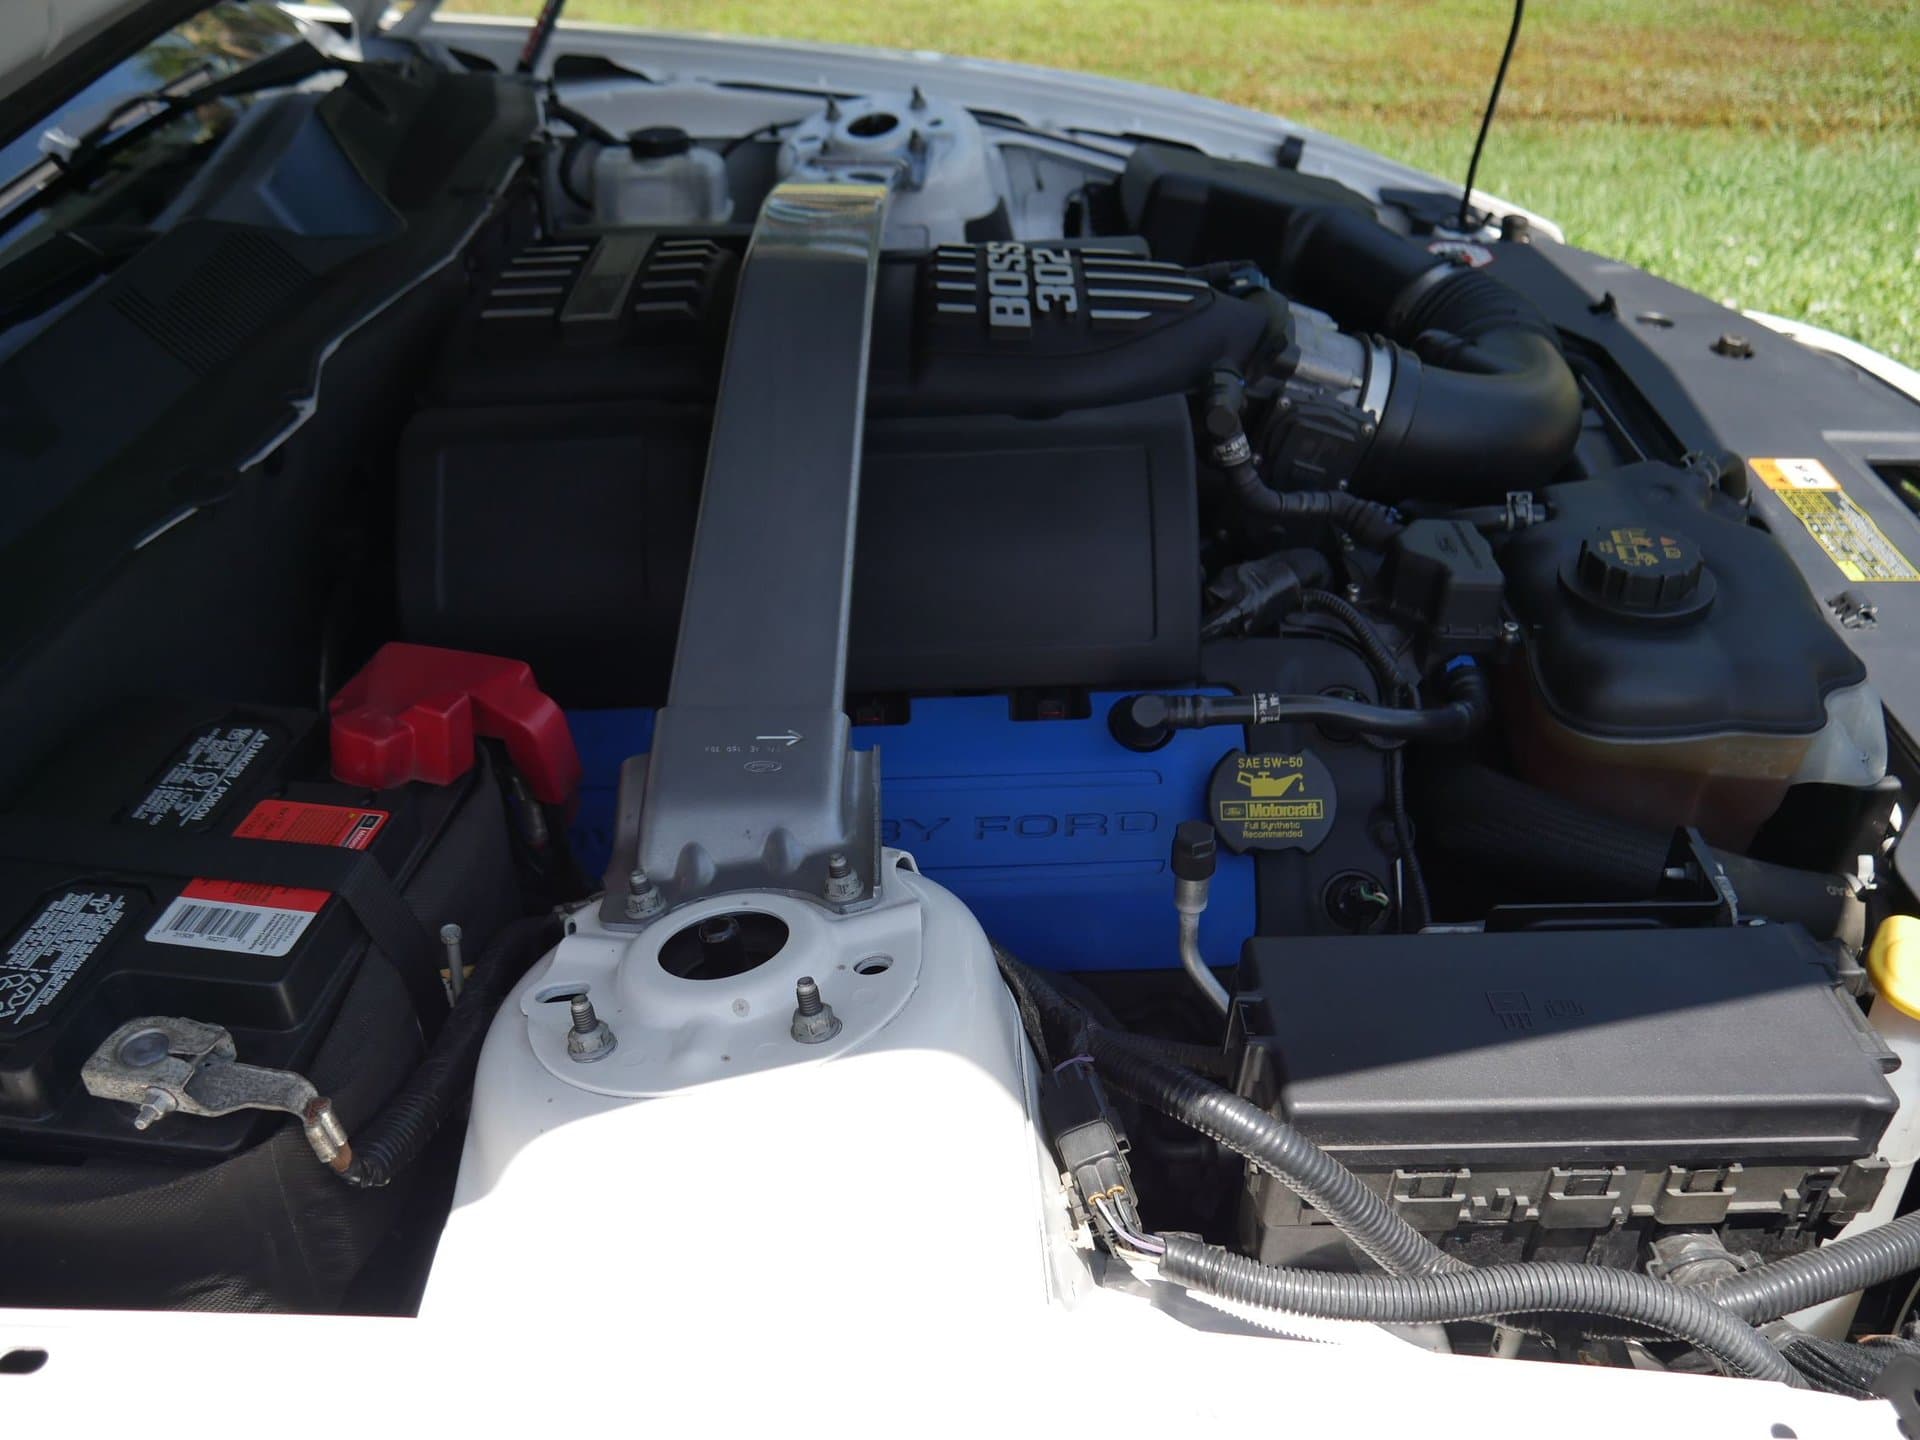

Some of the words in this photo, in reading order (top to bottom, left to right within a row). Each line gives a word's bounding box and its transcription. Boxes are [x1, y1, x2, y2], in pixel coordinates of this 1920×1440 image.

[987, 241, 1031, 327] BOSS
[1032, 248, 1077, 312] 302
[227, 742, 264, 778] DANGER
[1238, 758, 1260, 769] SAE
[1263, 757, 1303, 769] 5W-50
[190, 786, 228, 820] POISON
[1249, 802, 1318, 817] Motorcraft
[975, 811, 1158, 840] FORD
[1243, 830, 1303, 838] Recommended
[1244, 821, 1259, 831] Full
[1261, 821, 1300, 832] Synthetic
